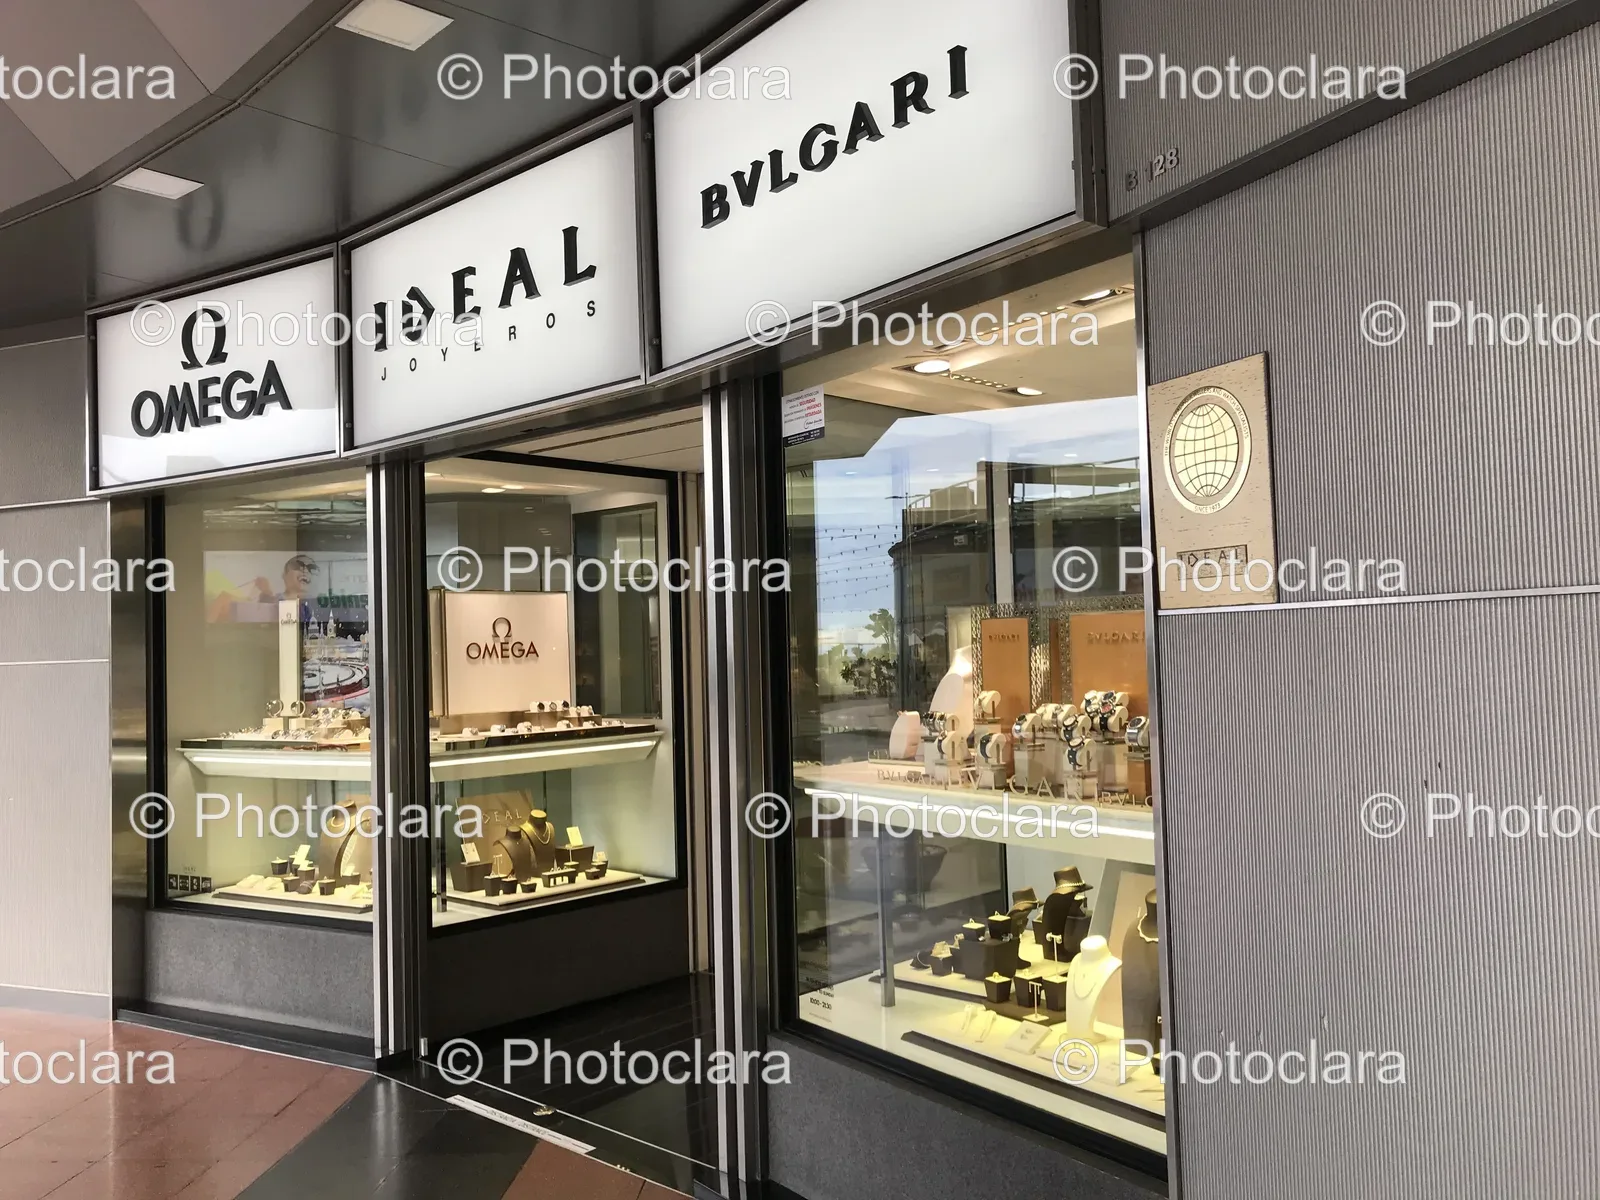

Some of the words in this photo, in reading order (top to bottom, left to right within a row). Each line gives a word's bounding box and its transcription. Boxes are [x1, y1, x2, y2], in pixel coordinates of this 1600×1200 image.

[700, 45, 970, 229] BVLGARI
[1144, 147, 1179, 182] 128
[373, 225, 597, 352] IDEAL
[381, 300, 596, 381] JOYEROS
[131, 360, 293, 437] OMEGA
[1223, 391, 1236, 405] WATCH
[466, 641, 539, 660] OMEGA
